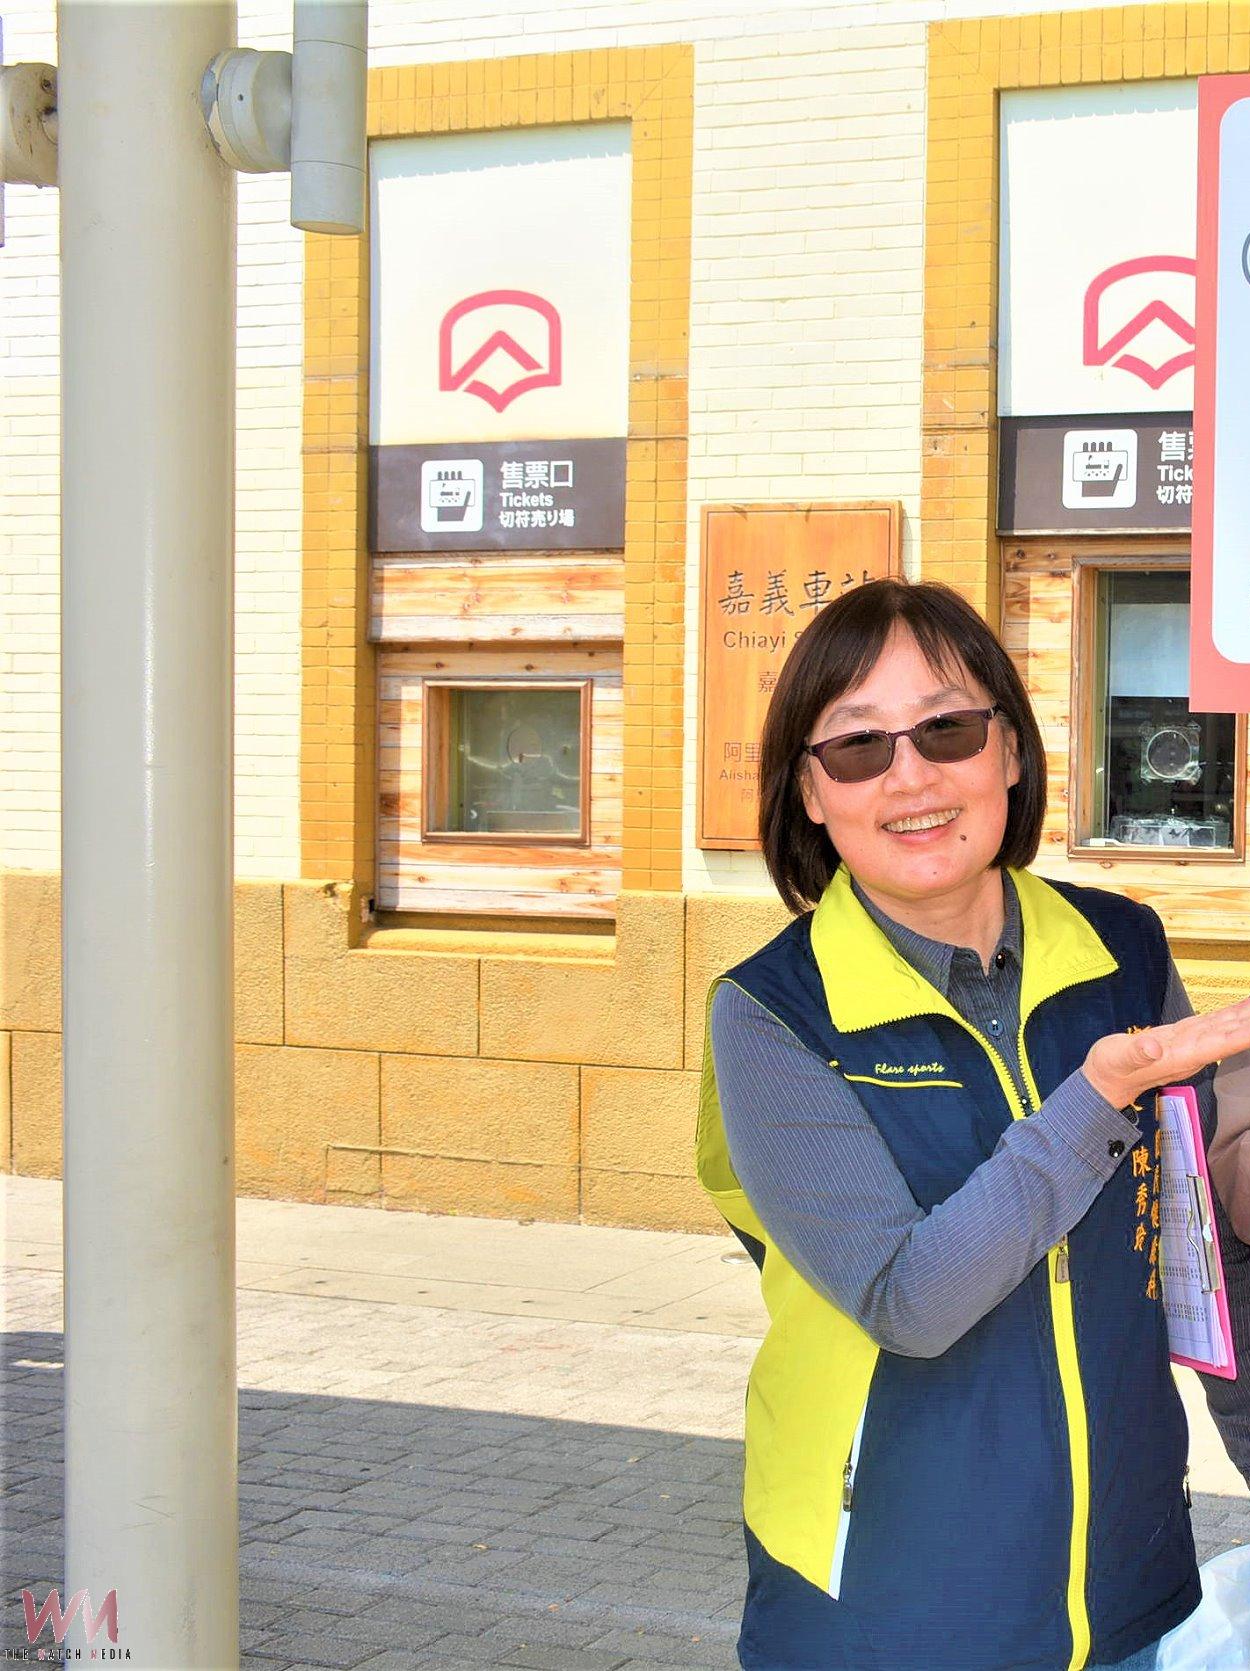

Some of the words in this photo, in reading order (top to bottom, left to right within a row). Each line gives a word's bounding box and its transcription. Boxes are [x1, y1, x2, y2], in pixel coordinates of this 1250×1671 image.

[1157, 431, 1193, 461] 售
[500, 460, 573, 489] 售票口
[499, 492, 553, 507] Tickets
[499, 509, 575, 528] 切符売り場
[723, 631, 786, 653] Chiayi
[907, 1062, 945, 1076] sports
